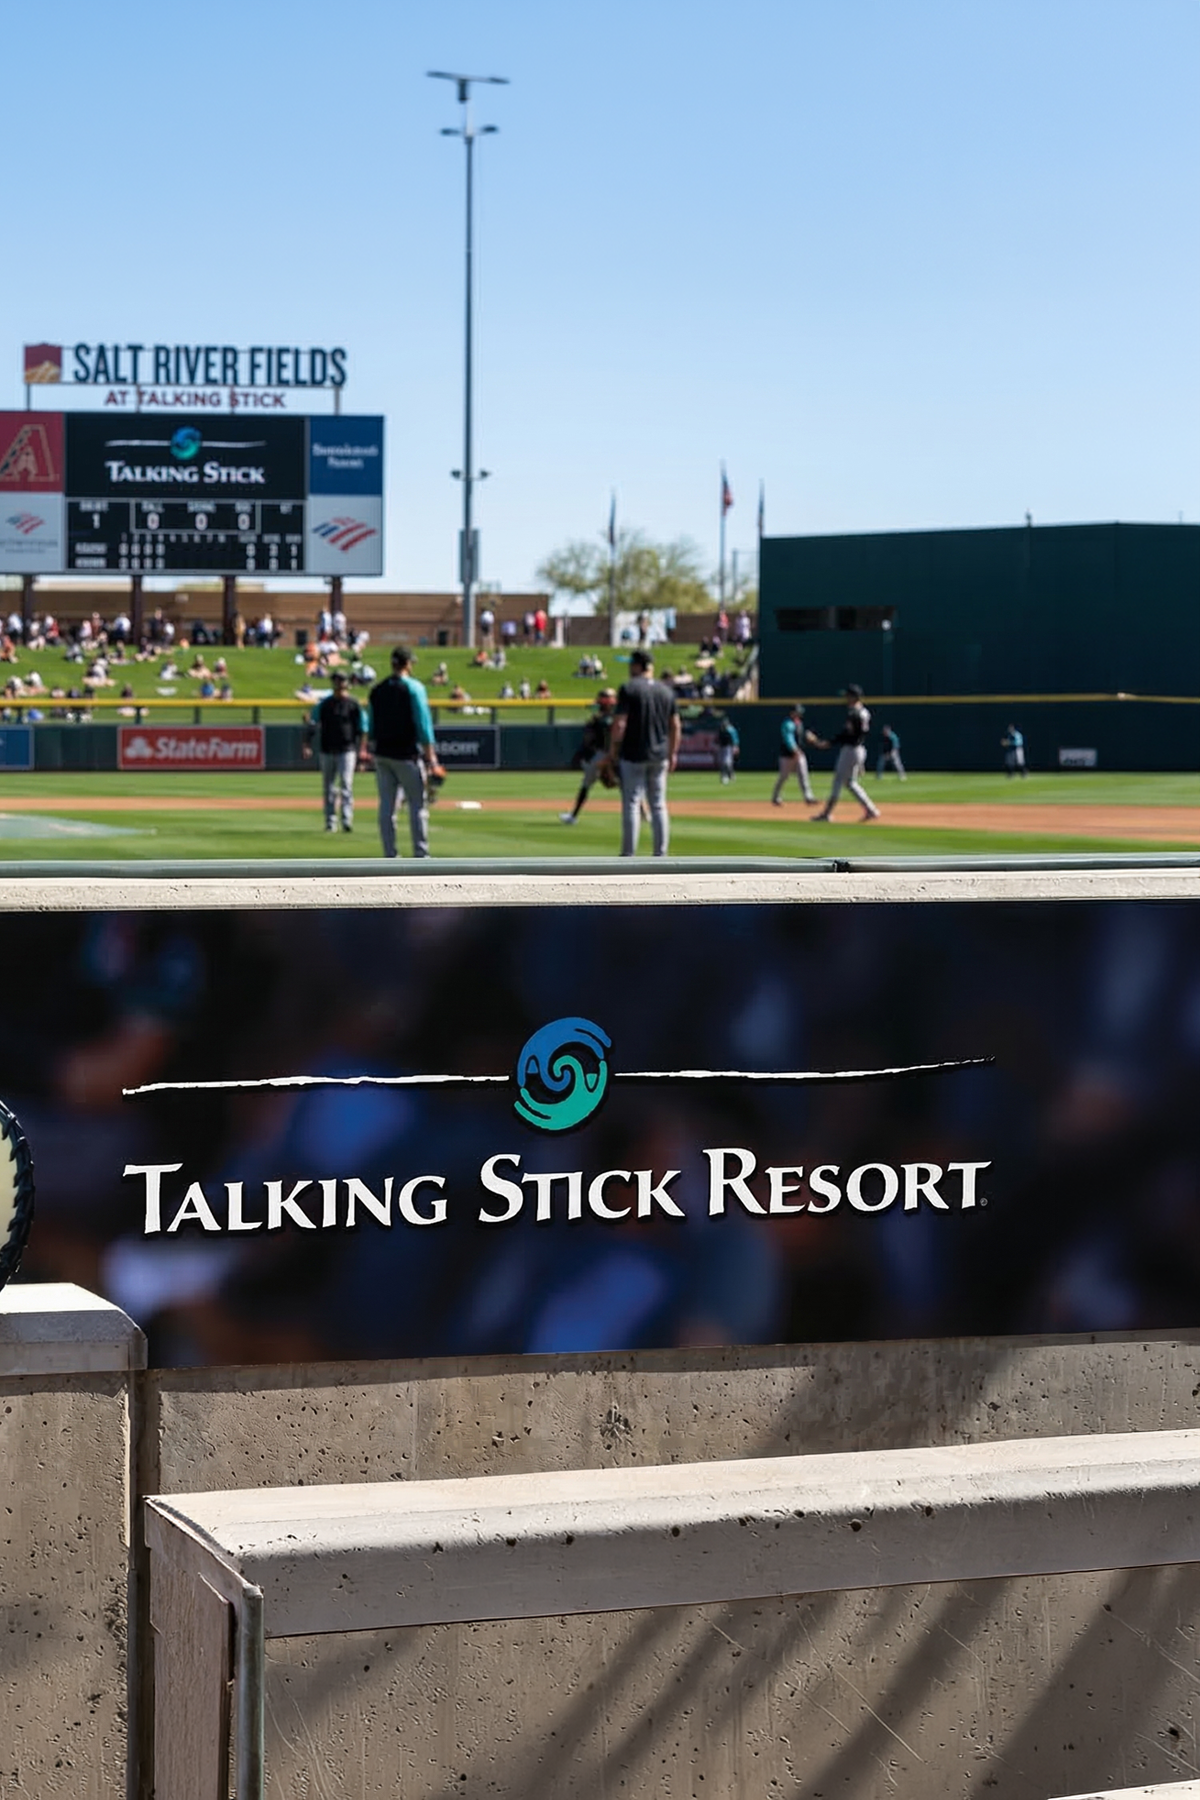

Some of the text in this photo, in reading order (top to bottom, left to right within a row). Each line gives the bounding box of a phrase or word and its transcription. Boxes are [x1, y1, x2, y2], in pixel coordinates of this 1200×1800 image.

[74, 344, 347, 387] SALT RIVER FIELDS
[104, 390, 286, 408] AT TALKING STICK
[105, 461, 266, 483] TALKING STICK
[123, 1163, 448, 1234] TALKING
[479, 1154, 686, 1222] STICK
